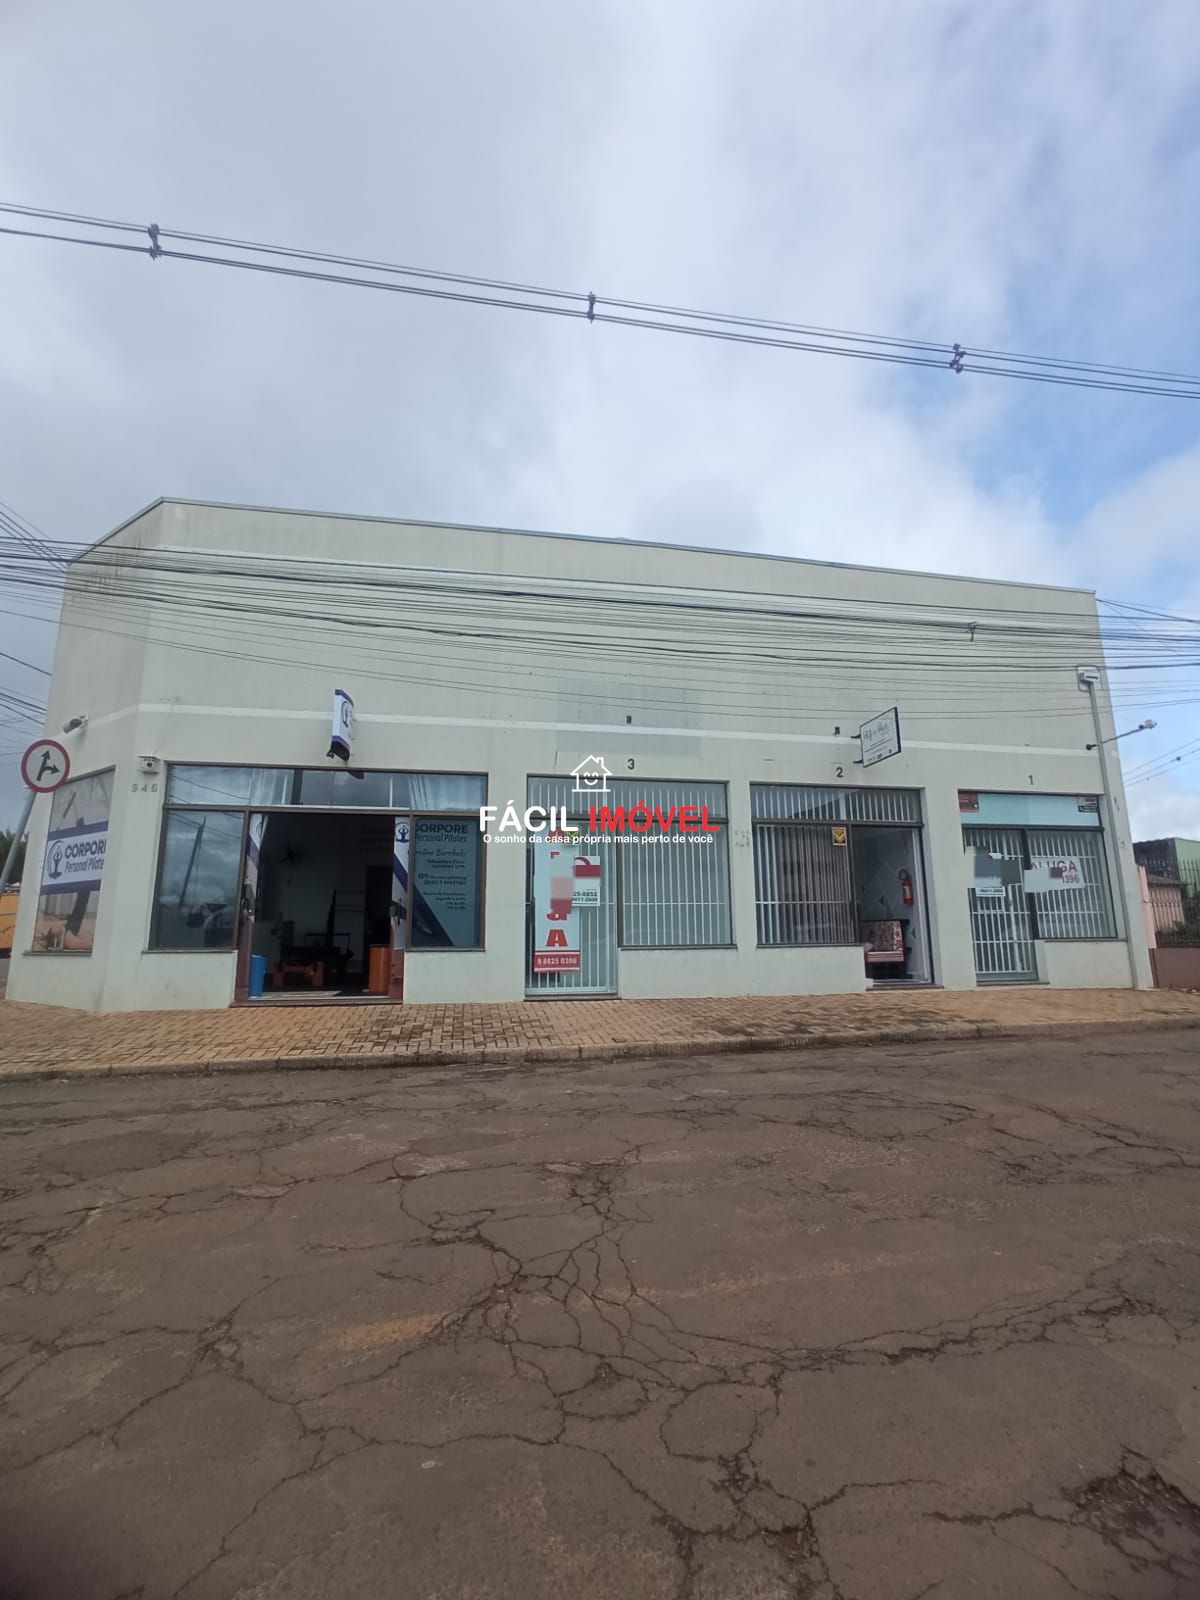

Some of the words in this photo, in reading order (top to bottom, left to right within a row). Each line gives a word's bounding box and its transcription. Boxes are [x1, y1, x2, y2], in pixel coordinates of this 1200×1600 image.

[627, 758, 635, 770] 3
[836, 766, 844, 778] 2
[1028, 774, 1034, 785] 1
[65, 838, 106, 859] CORPOR
[1062, 874, 1080, 884] 396
